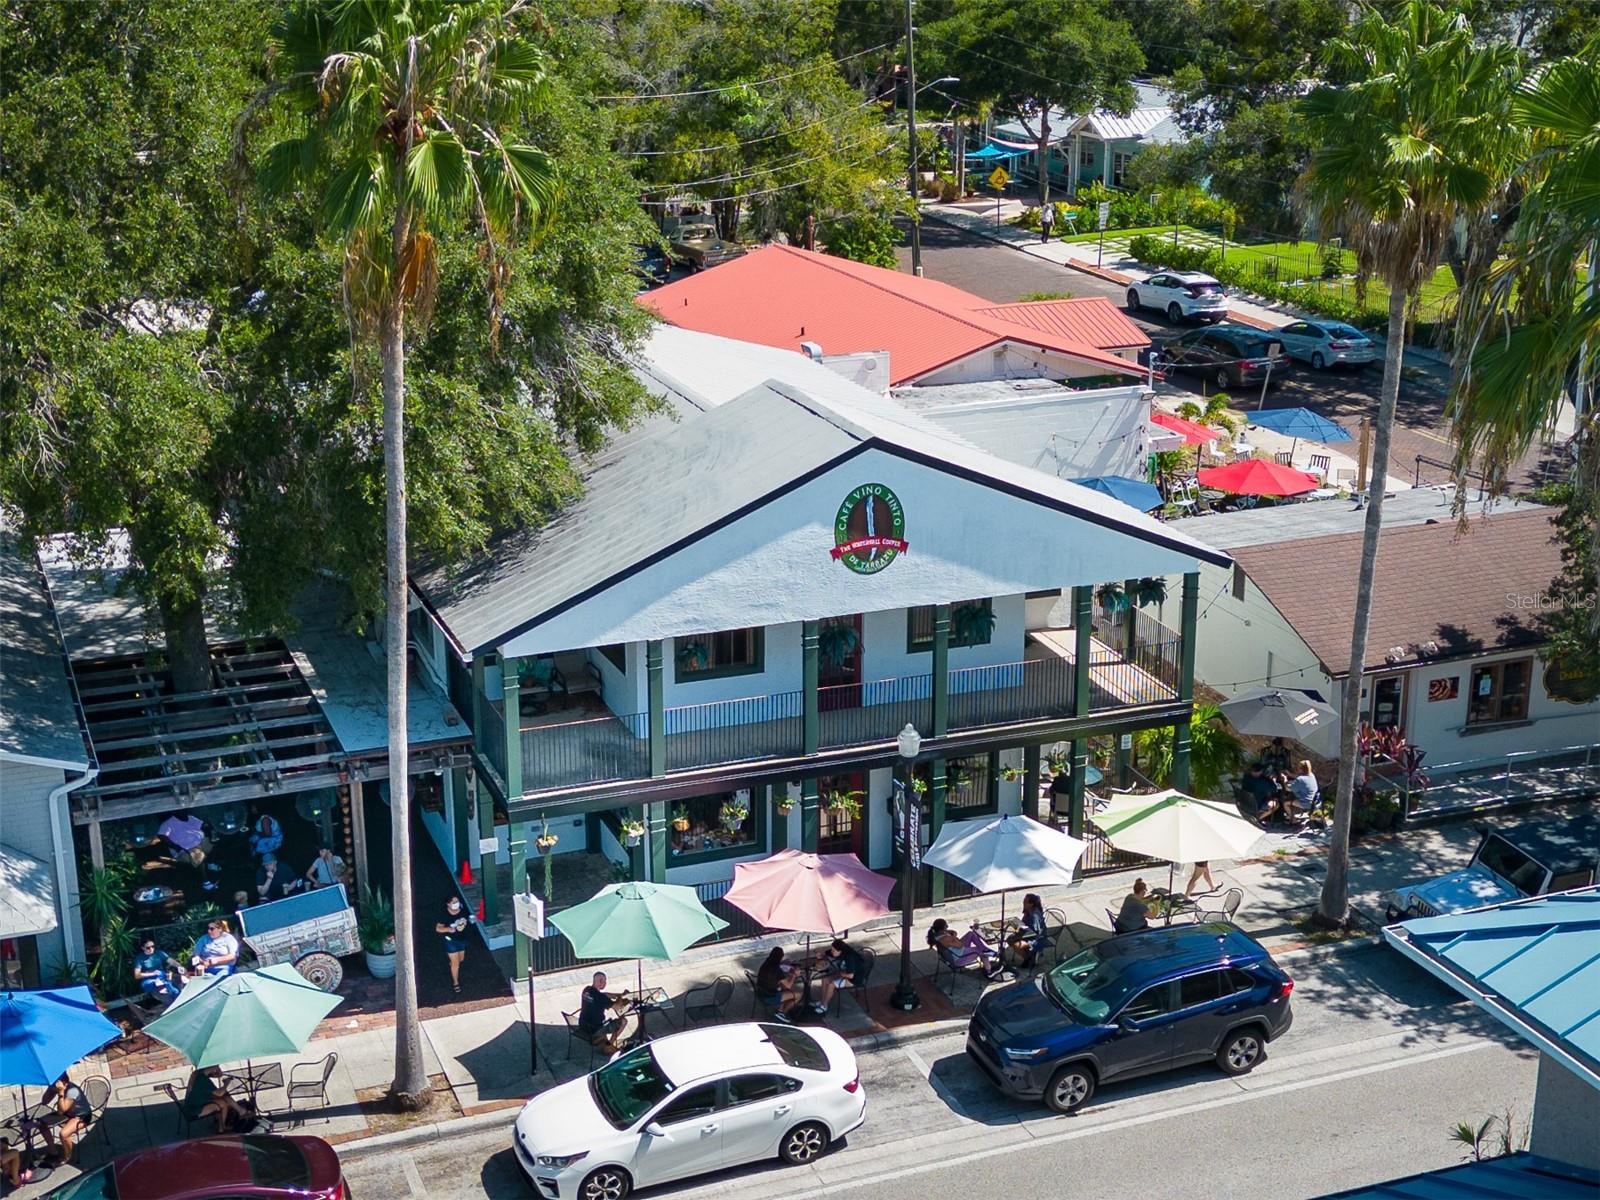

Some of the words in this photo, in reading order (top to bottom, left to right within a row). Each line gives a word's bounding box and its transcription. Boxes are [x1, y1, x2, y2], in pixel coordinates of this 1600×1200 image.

[838, 501, 854, 531] CAFE
[853, 486, 882, 499] VINO
[884, 493, 902, 526] TINTO
